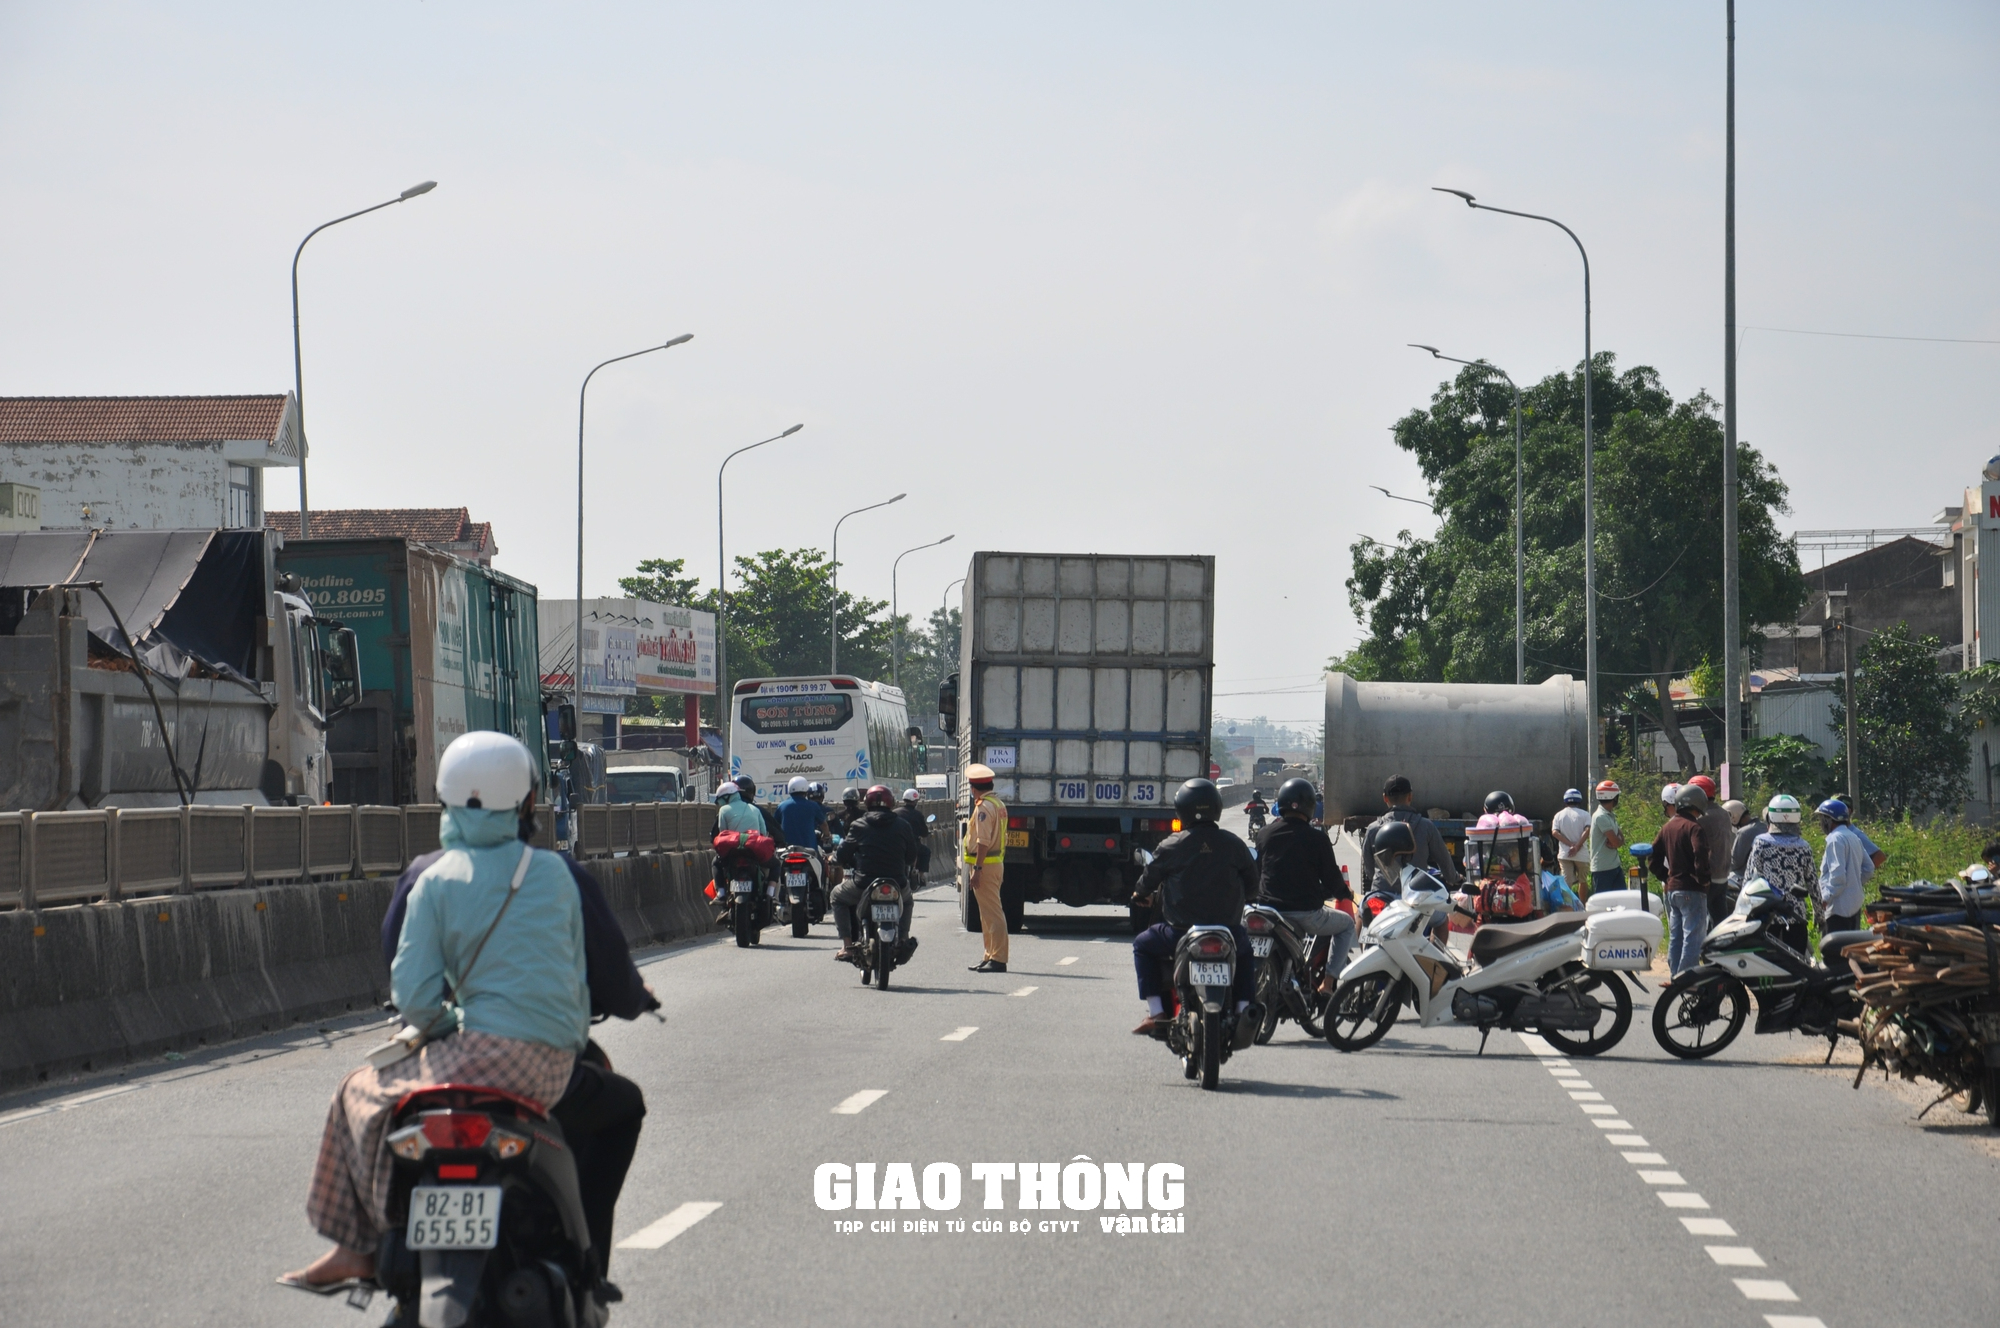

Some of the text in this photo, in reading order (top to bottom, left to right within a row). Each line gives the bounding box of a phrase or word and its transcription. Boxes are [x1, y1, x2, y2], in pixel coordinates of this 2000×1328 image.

[300, 575, 353, 588] Hotline
[307, 588, 386, 605] 00.8095
[776, 684, 794, 693] 1900
[820, 683, 827, 691] 37
[756, 705, 789, 719] SƠN
[757, 741, 768, 749] QUY
[809, 738, 818, 746] ĐÀ
[1059, 782, 1155, 801] 76H 009 .53
[1598, 945, 1629, 960] CẢNH
[1196, 963, 1224, 973] 76-C1
[1193, 973, 1229, 985] 403.15
[425, 1191, 486, 1218] 82-B1
[413, 1218, 492, 1246] 655.55
